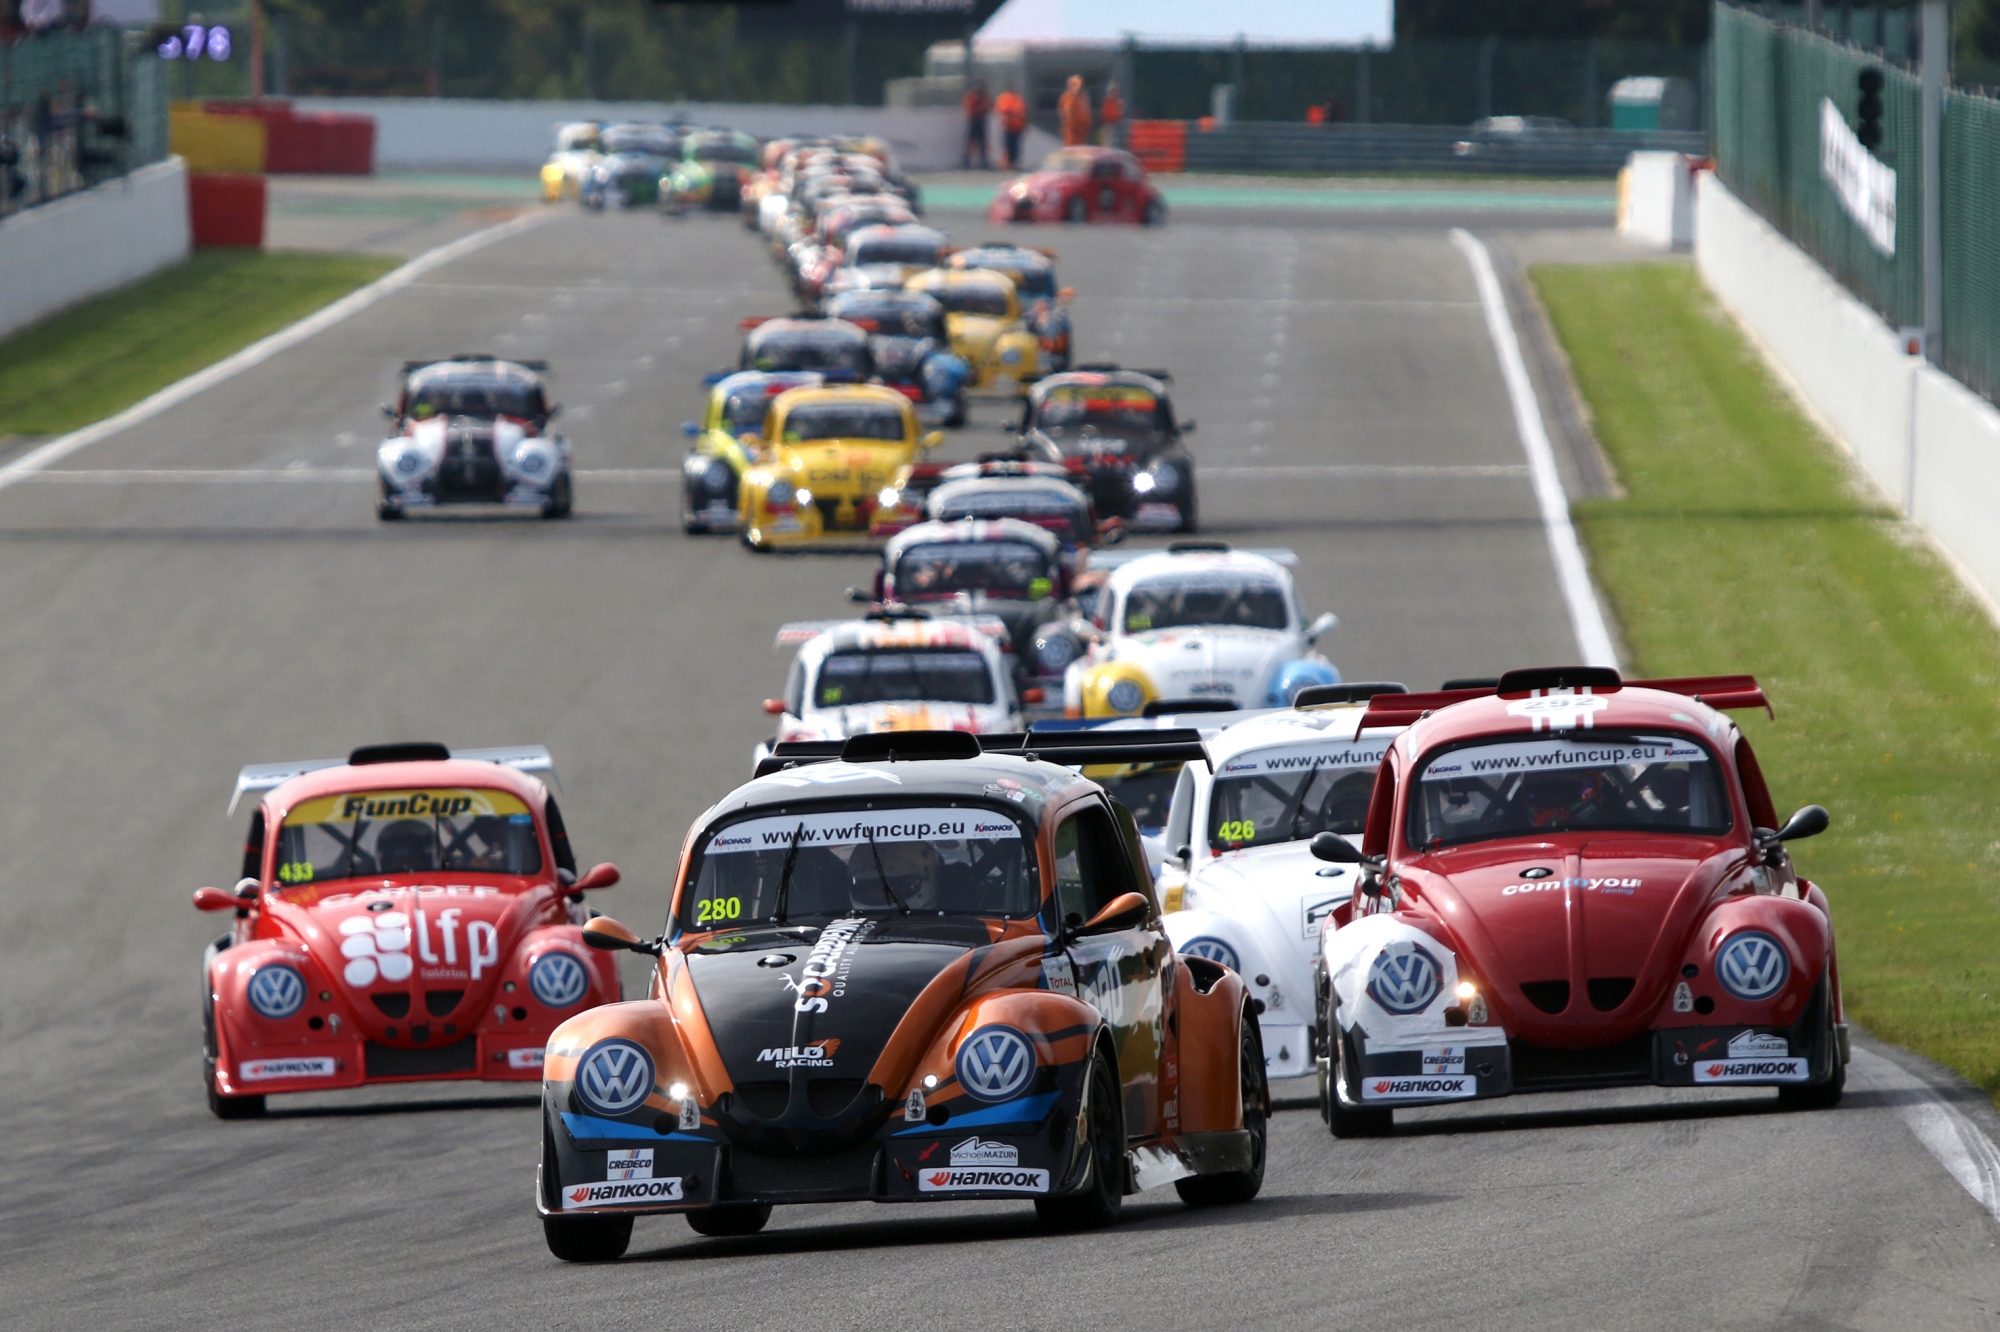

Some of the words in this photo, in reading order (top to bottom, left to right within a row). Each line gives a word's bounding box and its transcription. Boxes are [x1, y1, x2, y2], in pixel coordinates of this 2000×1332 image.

[1266, 750, 1385, 769] www.vwfunc
[1471, 746, 1656, 771] www.vwfuncup.eu
[342, 794, 471, 818] FunCup
[762, 821, 965, 845] www.vwfuncup.eu
[974, 822, 1013, 832] KRONOS
[1219, 820, 1256, 841] 426
[714, 836, 752, 847] KRONOS
[279, 862, 314, 883] 433
[697, 896, 741, 921] 280
[414, 908, 499, 980] lfp
[1049, 977, 1073, 988] TOTAL
[775, 1058, 834, 1068] RACING
[1423, 1055, 1465, 1065] CREDECO
[608, 1158, 653, 1170] CREDECO
